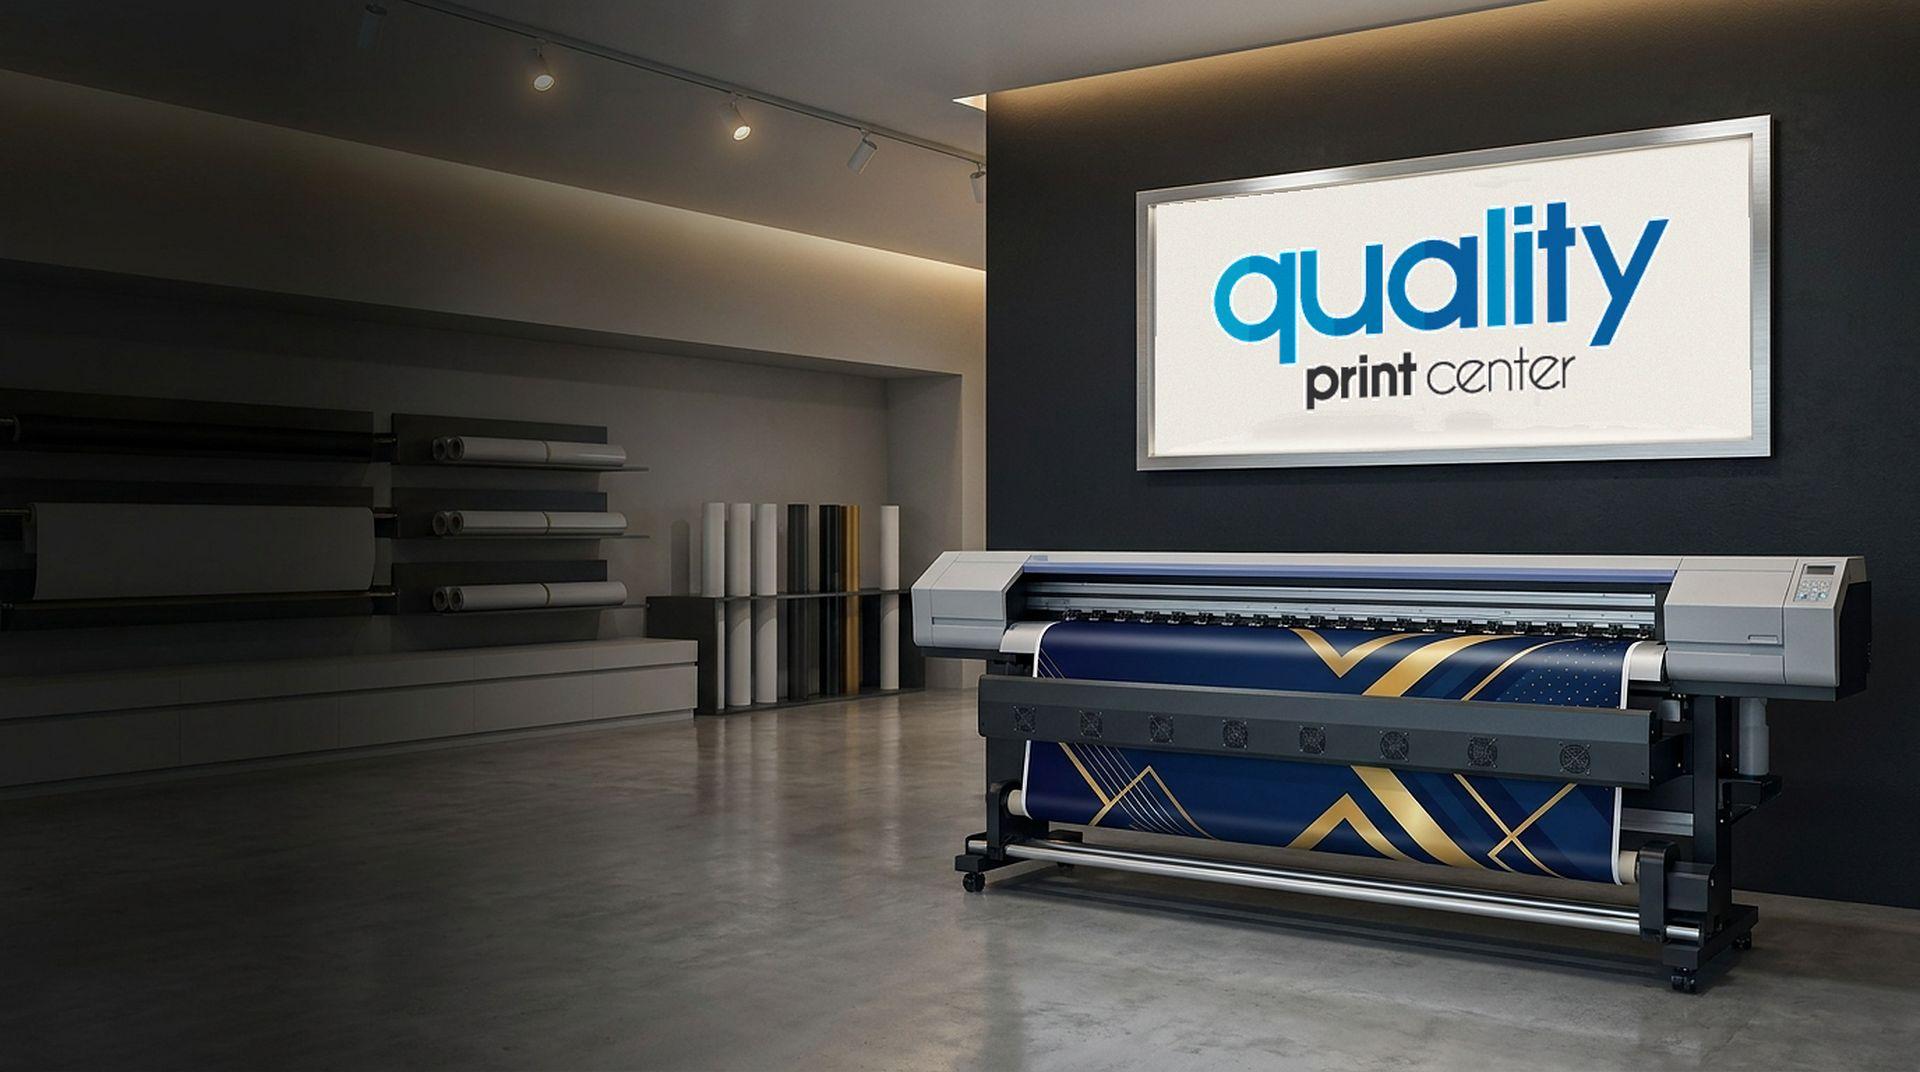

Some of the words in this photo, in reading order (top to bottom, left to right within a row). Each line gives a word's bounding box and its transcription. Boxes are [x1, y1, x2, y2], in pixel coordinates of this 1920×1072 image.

[1213, 201, 1670, 365] quality
[1306, 352, 1417, 410] print
[1426, 347, 1576, 396] center
